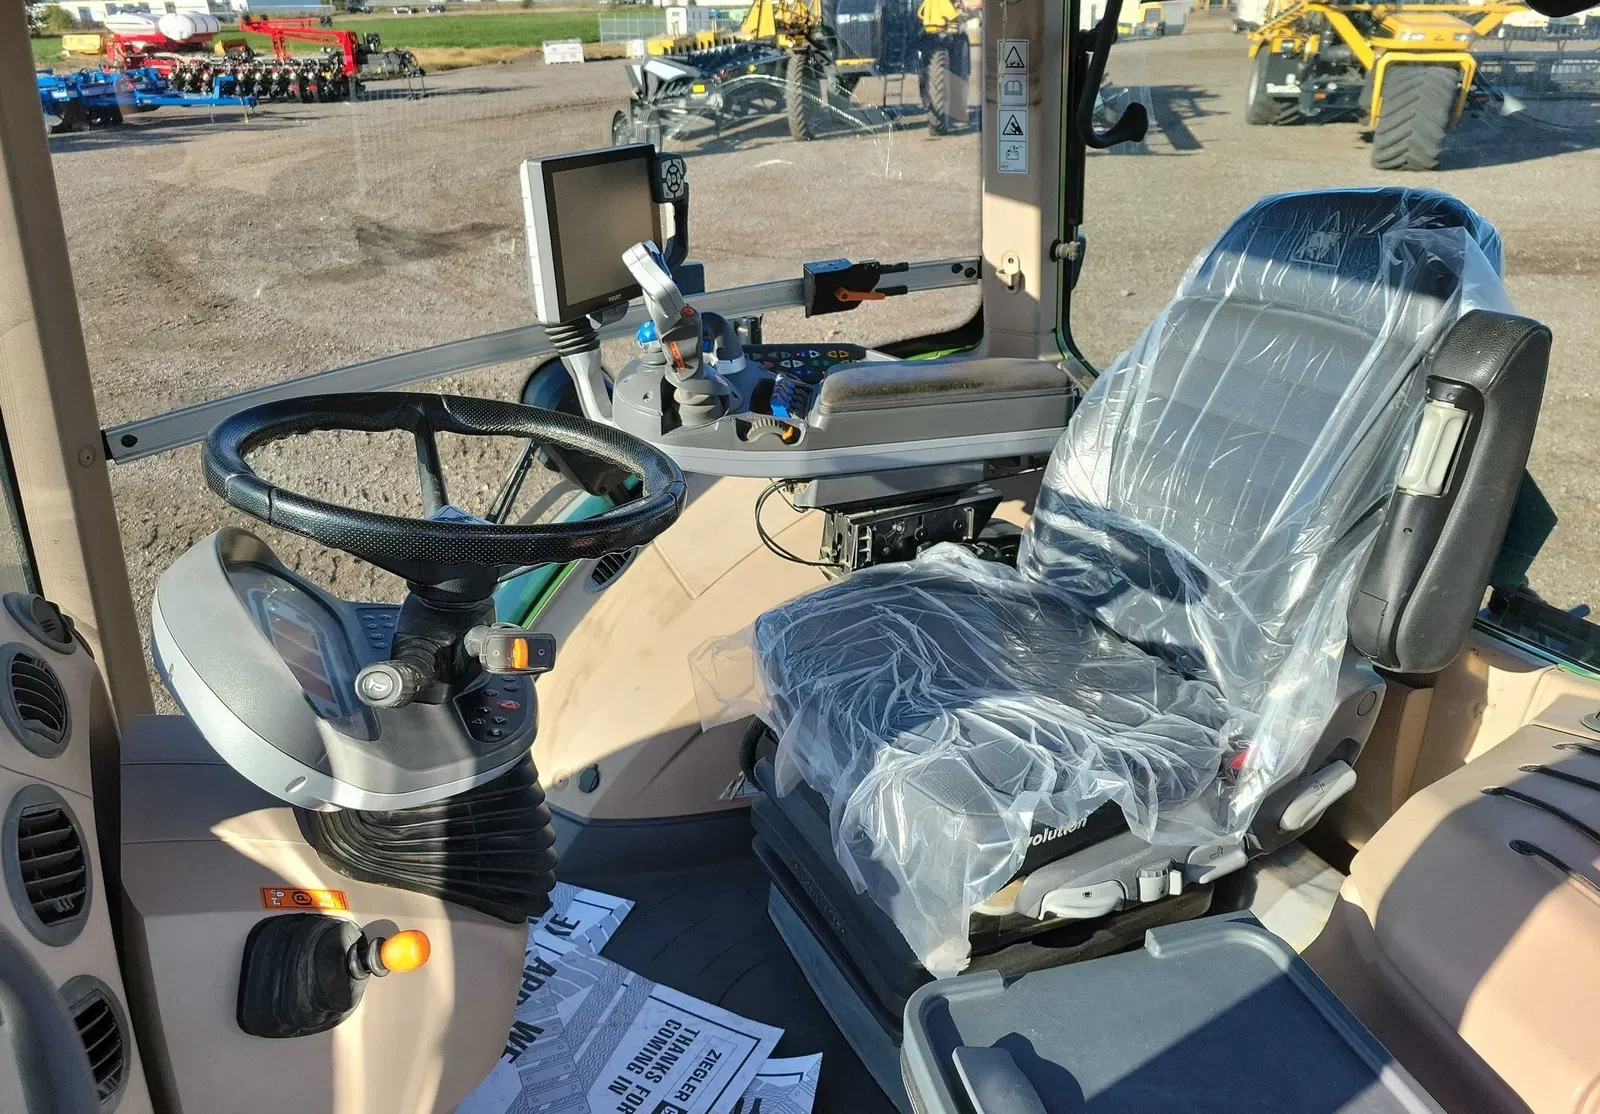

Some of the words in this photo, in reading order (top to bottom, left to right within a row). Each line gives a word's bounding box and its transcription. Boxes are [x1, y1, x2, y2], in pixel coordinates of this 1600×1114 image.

[625, 1018, 682, 1075] COMING
[644, 1027, 701, 1084] THANKS
[607, 1075, 633, 1096] IN
[616, 1084, 652, 1114] FOR
[674, 1048, 723, 1103] ZIEGLER
